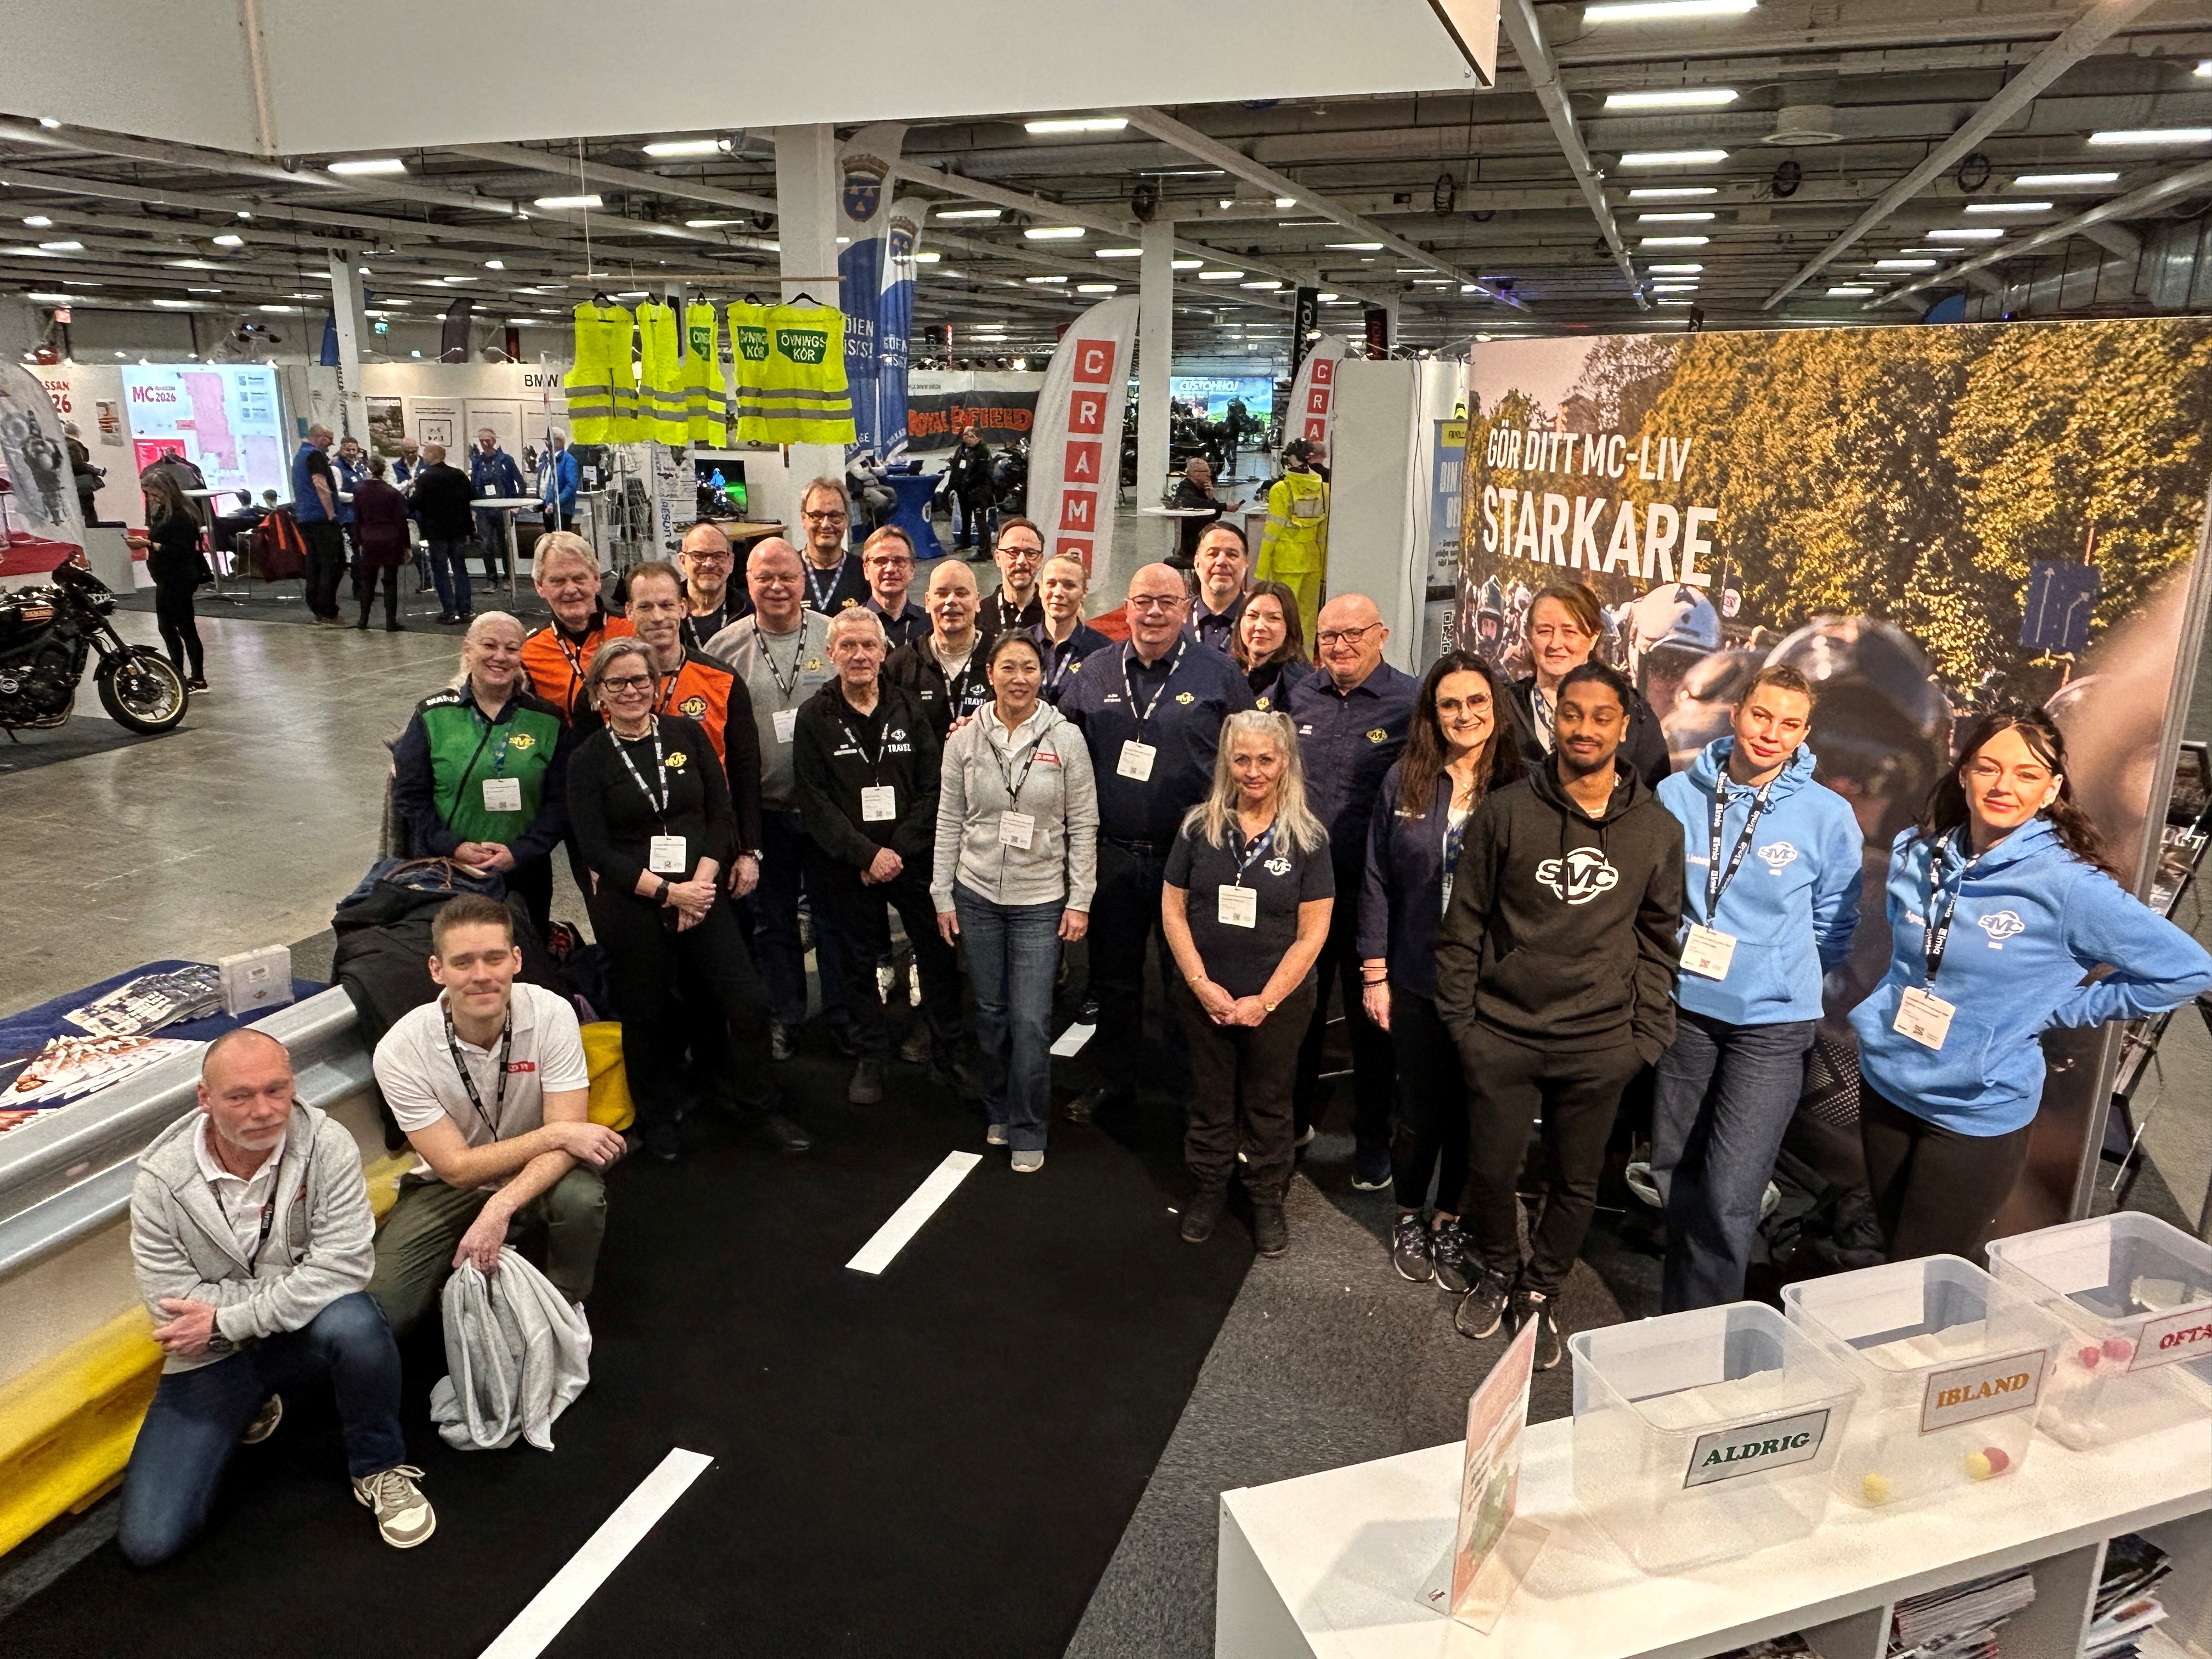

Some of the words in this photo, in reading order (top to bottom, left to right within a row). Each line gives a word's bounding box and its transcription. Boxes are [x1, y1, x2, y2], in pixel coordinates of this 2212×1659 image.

[781, 332, 826, 347] ÖVNINGS
[793, 346, 815, 361] KÖR
[43, 381, 70, 391] SSAN
[524, 374, 558, 387] BMW
[132, 386, 154, 403] MC
[155, 392, 176, 402] 2026
[1487, 419, 1521, 469] GÖR
[1523, 428, 1578, 474] DITT
[1582, 433, 1692, 482] MC-LIV
[1483, 484, 1718, 588] STARKARE
[1263, 857, 1292, 876] SMC
[1757, 841, 1798, 867] SMC
[1535, 847, 1619, 905] SMC
[1978, 910, 2025, 940] SMC
[1933, 928, 1948, 955] Elmia
[1936, 1373, 2030, 1409] IBLAND
[1701, 1432, 1810, 1467] ALDRIG
